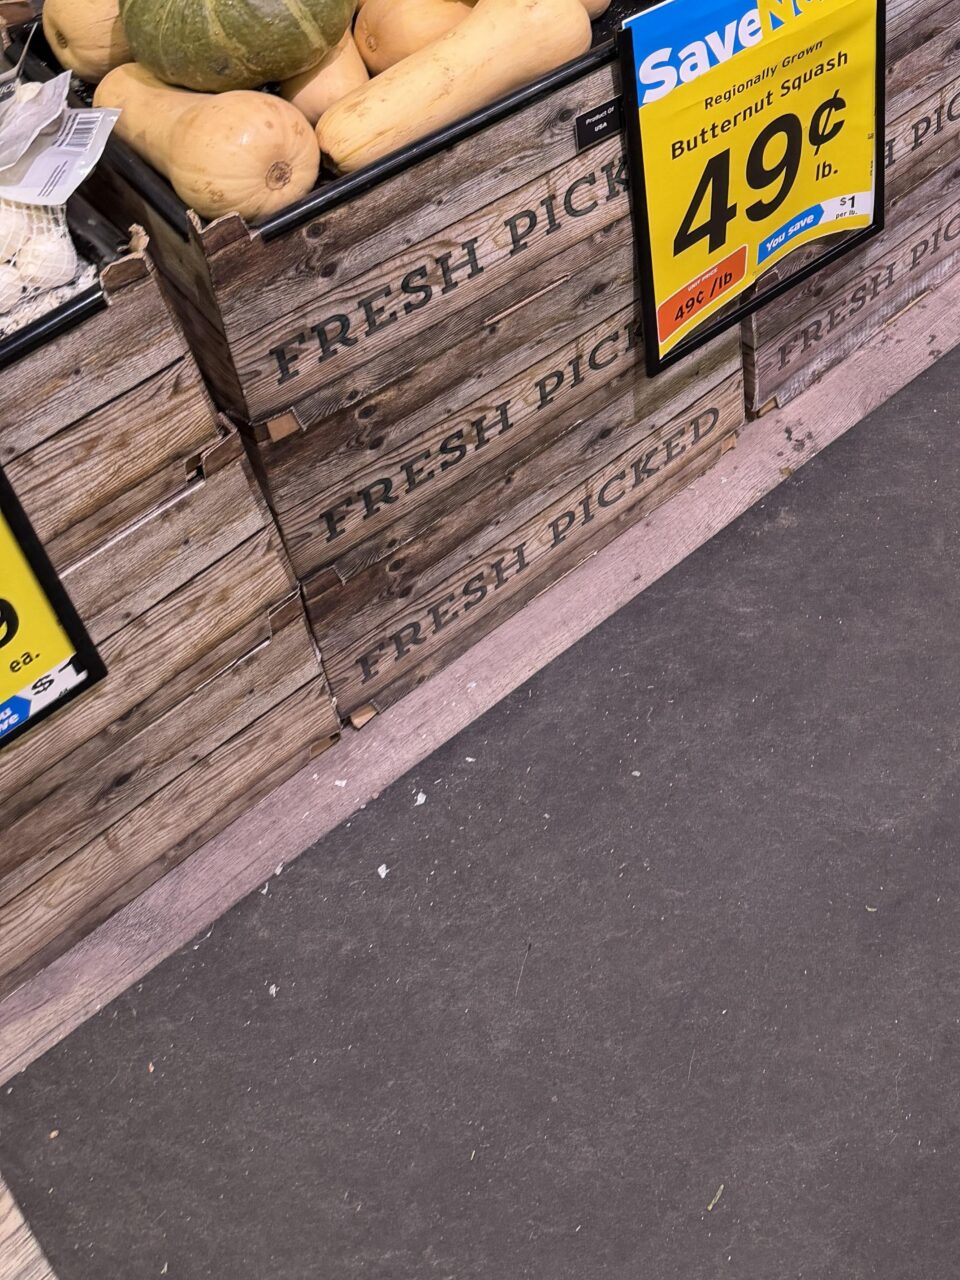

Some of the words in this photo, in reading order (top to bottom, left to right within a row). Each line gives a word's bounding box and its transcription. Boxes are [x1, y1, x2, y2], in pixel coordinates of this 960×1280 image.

[671, 89, 774, 160] Butternut
[780, 50, 849, 98] Squash
[704, 64, 778, 110] Regionally
[782, 40, 823, 69] Grown
[673, 88, 847, 258] 49¢
[815, 160, 839, 182] lb.
[269, 237, 485, 386] FRESH
[503, 155, 631, 257] PICK
[766, 232, 786, 252] You
[787, 213, 816, 237] save
[674, 289, 705, 322] 49¢
[710, 271, 733, 298] /lb
[777, 261, 898, 371] FRESH
[319, 400, 514, 543] FRESH
[355, 541, 530, 685] FRESH
[548, 407, 720, 549] PICKED
[9, 650, 41, 674] ea.
